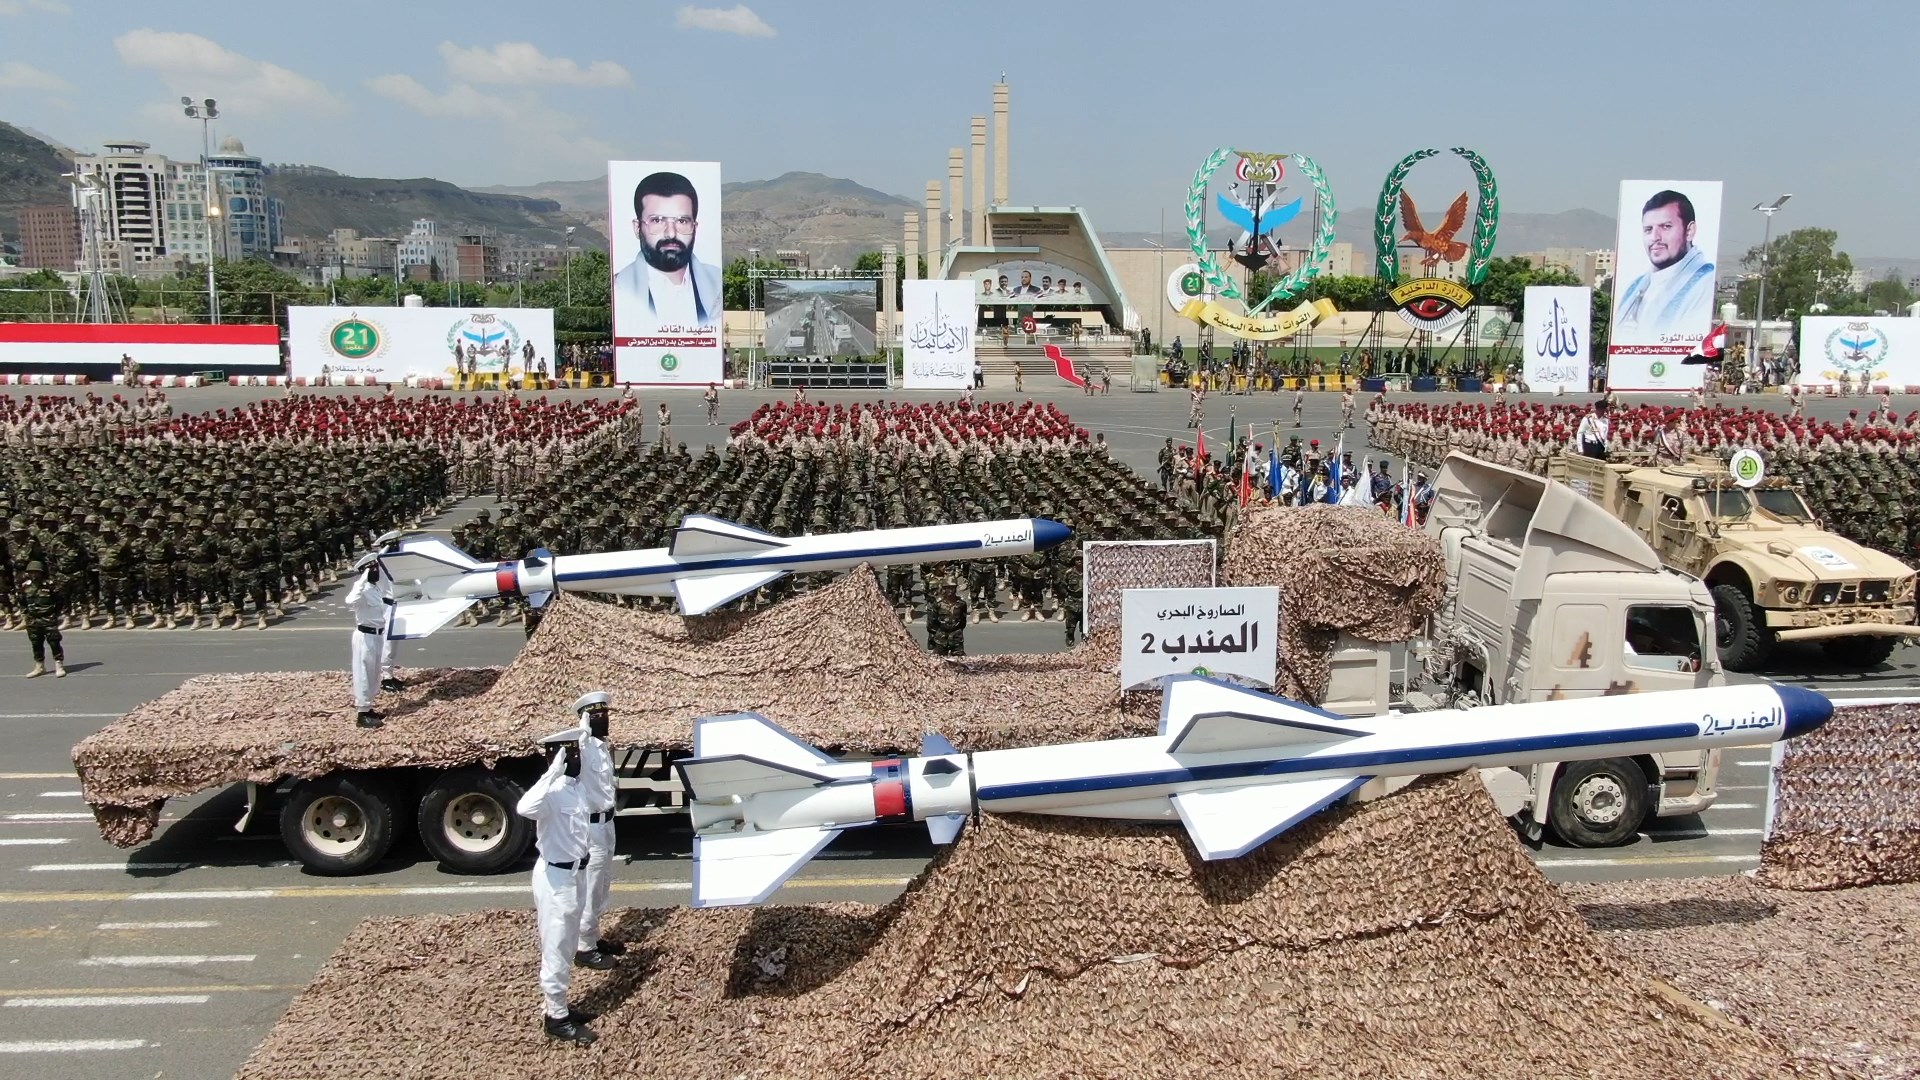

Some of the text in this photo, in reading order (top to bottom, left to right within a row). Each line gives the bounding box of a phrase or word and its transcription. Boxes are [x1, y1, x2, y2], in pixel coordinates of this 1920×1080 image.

[1187, 277, 1199, 287] 21
[1400, 282, 1464, 300] وزارة الداخلية
[1214, 312, 1311, 333] القوات المسلحة اليمنية
[658, 325, 717, 336] الشهيد القائد
[342, 328, 369, 345] 21
[1660, 333, 1704, 343] قائد الثورة
[627, 338, 650, 347] الحوثي
[677, 338, 695, 347] حسين
[1741, 460, 1752, 471] 21
[1157, 603, 1245, 620] الصاروخ البحري
[1140, 620, 1259, 662] المندب 2
